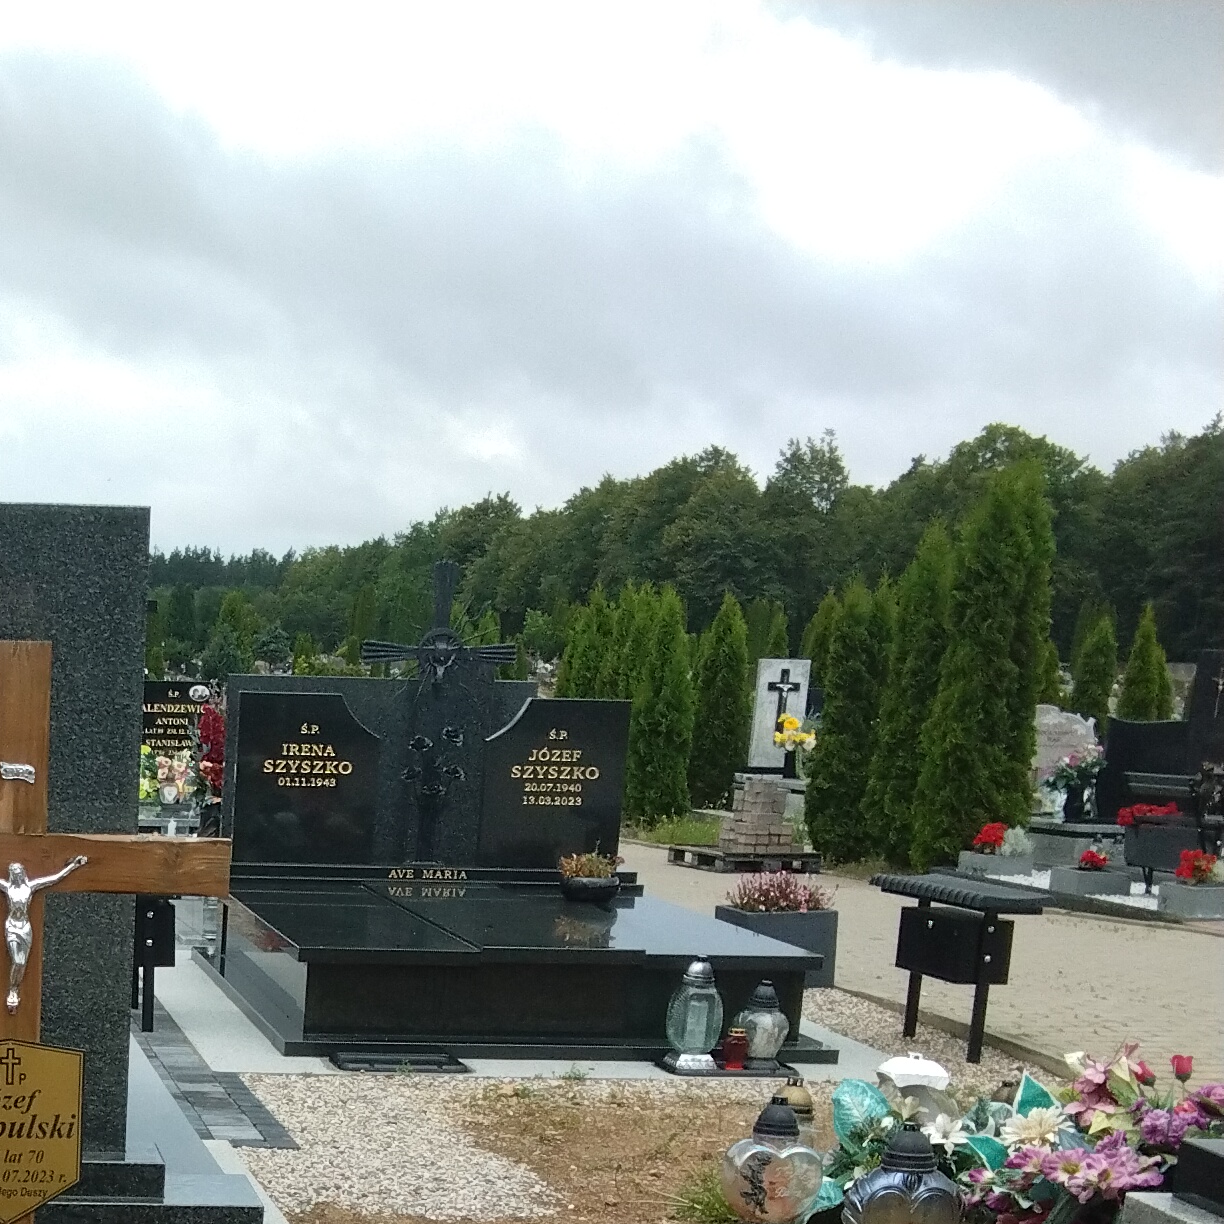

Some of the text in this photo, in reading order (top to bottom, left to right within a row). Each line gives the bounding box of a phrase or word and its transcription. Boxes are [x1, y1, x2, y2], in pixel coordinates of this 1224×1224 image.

[155, 717, 189, 726] ANTONI
[300, 722, 320, 734] Ś.P.
[145, 739, 195, 747] STANISŁAW
[281, 743, 336, 757] IRENA
[528, 746, 582, 762] JÓZEF
[263, 760, 353, 775] SZYSZKO
[511, 765, 600, 780] SZYSZKO
[277, 777, 337, 788] 01.11.1943
[524, 783, 582, 793] 20.07.1940
[522, 795, 582, 806] 13.03.2023
[388, 869, 467, 880] AVE MARIA
[19, 1073, 26, 1085] P
[4, 1149, 23, 1164] lat
[28, 1150, 45, 1164] 70
[58, 1173, 67, 1184] r.
[20, 1187, 48, 1199] Duszy
